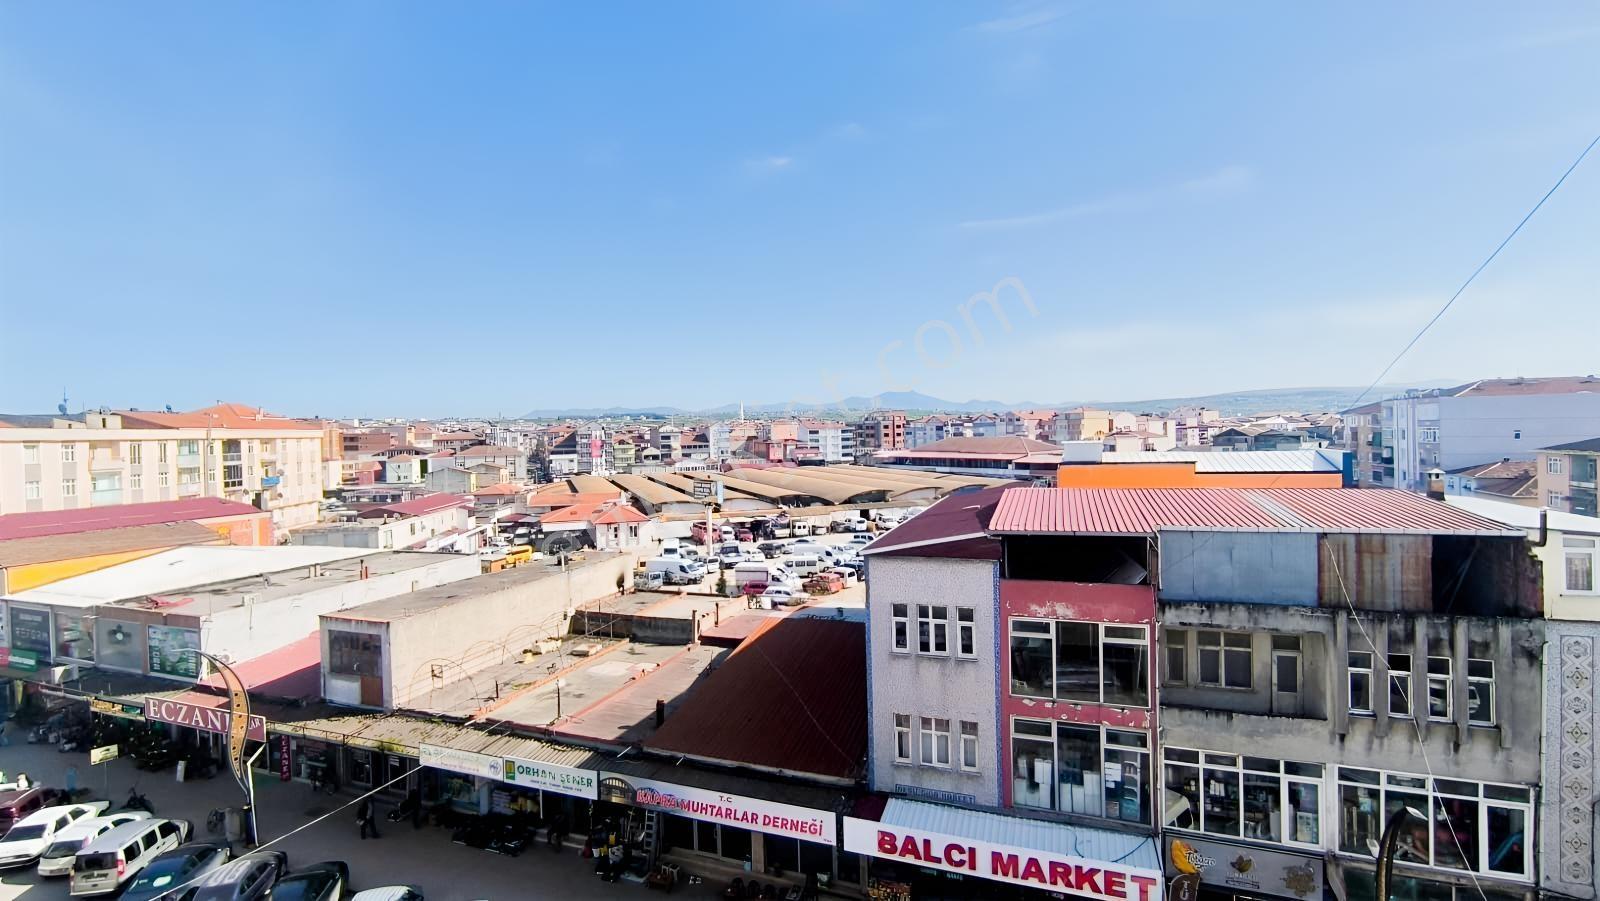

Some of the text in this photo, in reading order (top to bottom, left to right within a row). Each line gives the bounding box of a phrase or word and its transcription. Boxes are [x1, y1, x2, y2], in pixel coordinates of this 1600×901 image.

[517, 765, 556, 781] ORHAN
[679, 799, 759, 825] MUHTARLAR
[762, 814, 823, 836] DERNEĞİ
[877, 830, 977, 871] BALCI
[991, 851, 1156, 901] MARKET
